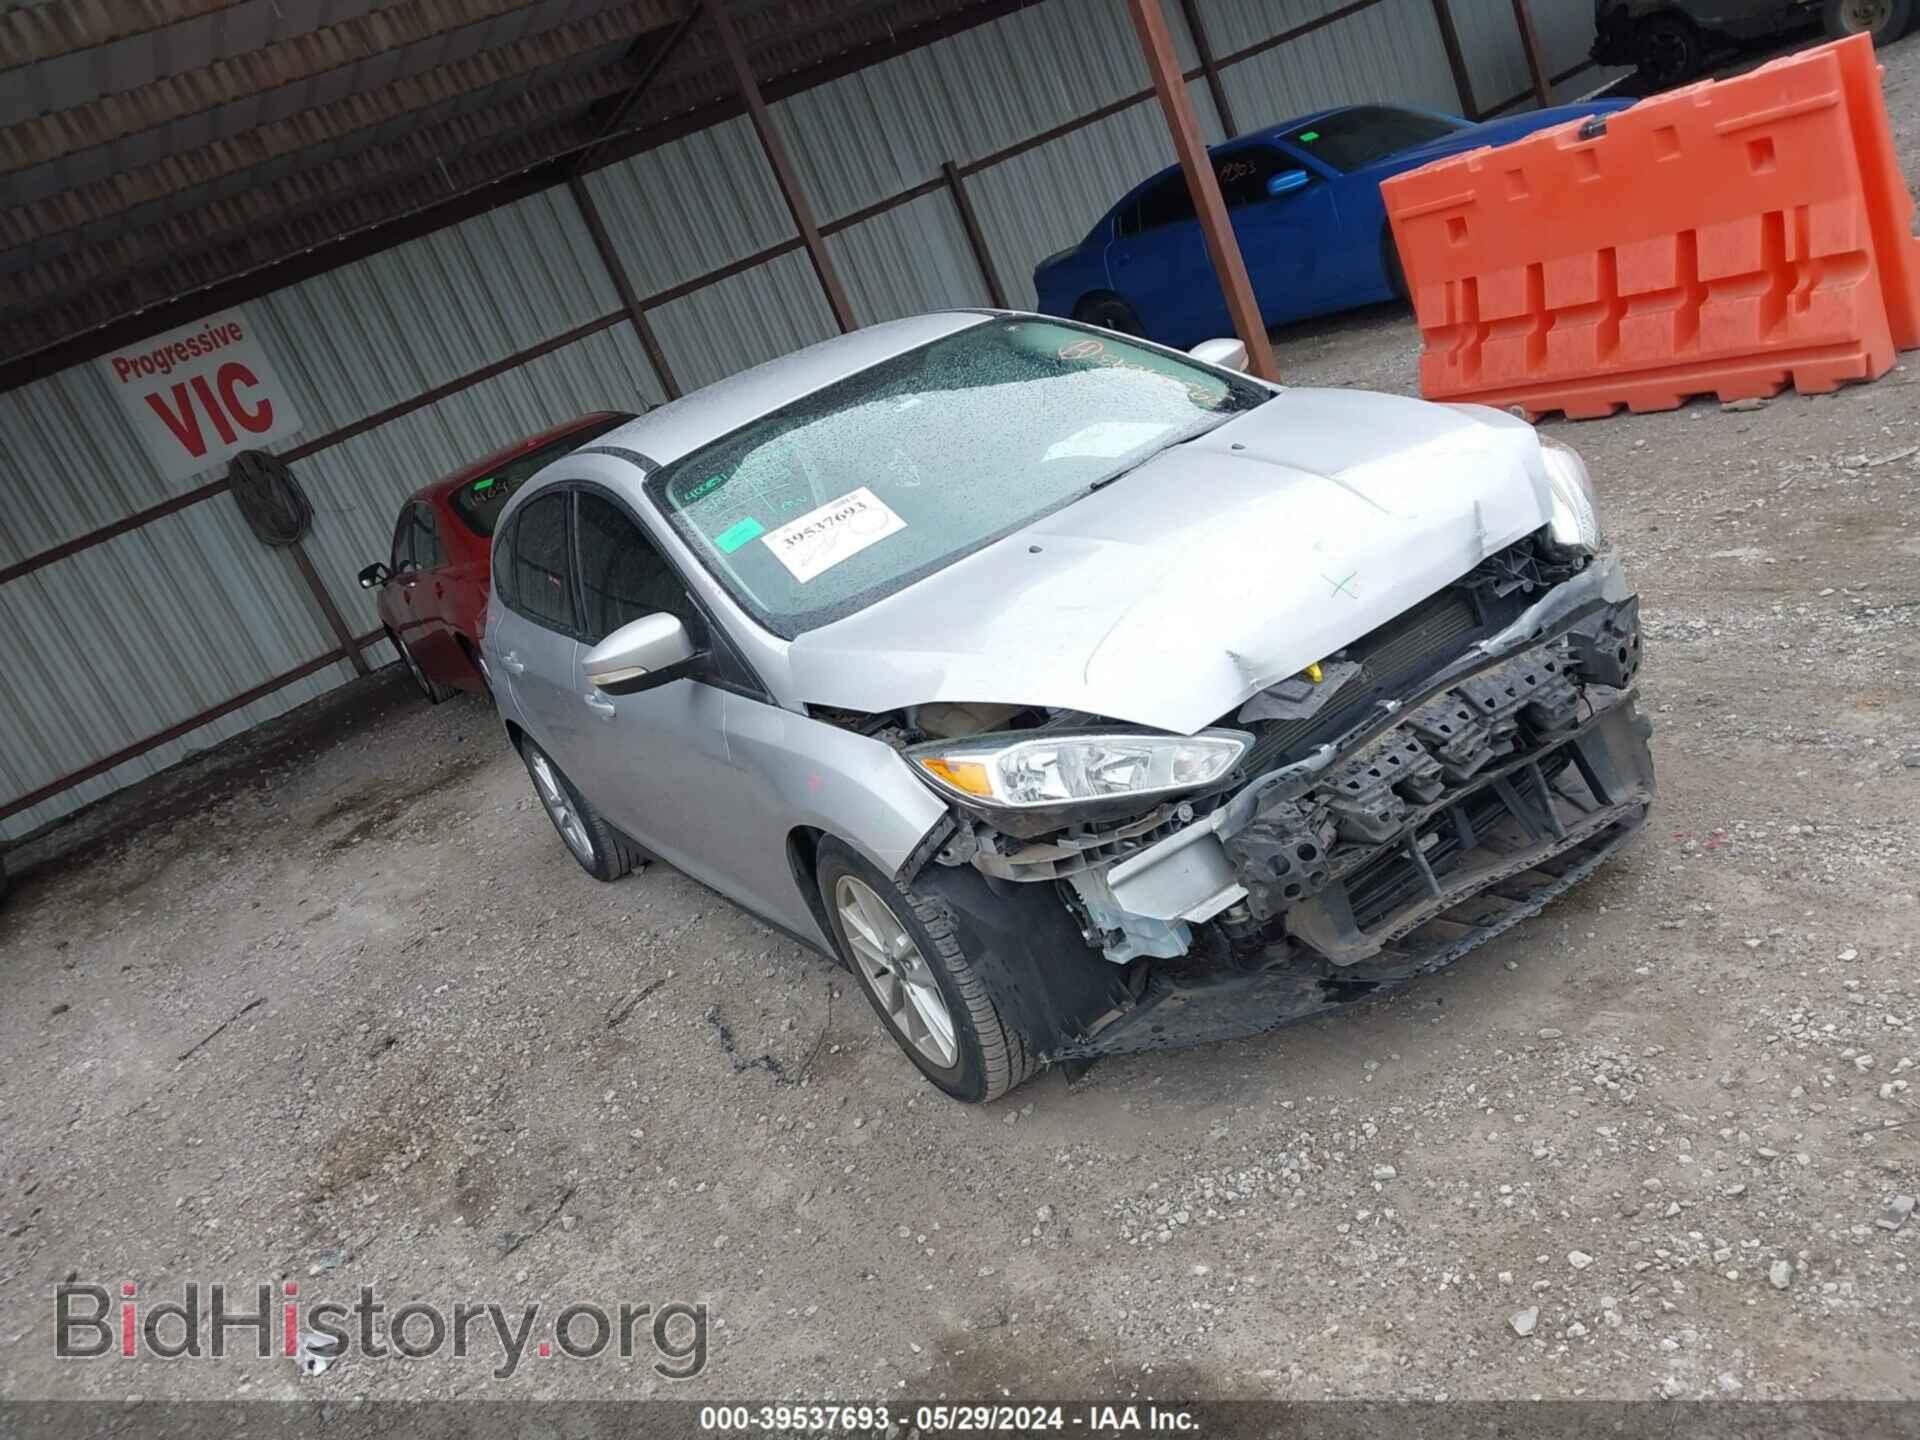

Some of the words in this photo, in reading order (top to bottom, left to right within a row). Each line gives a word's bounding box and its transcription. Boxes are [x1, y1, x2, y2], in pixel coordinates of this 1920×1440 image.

[111, 321, 244, 384] Progressive
[144, 361, 274, 457] VIC
[783, 501, 868, 550] 39537693
